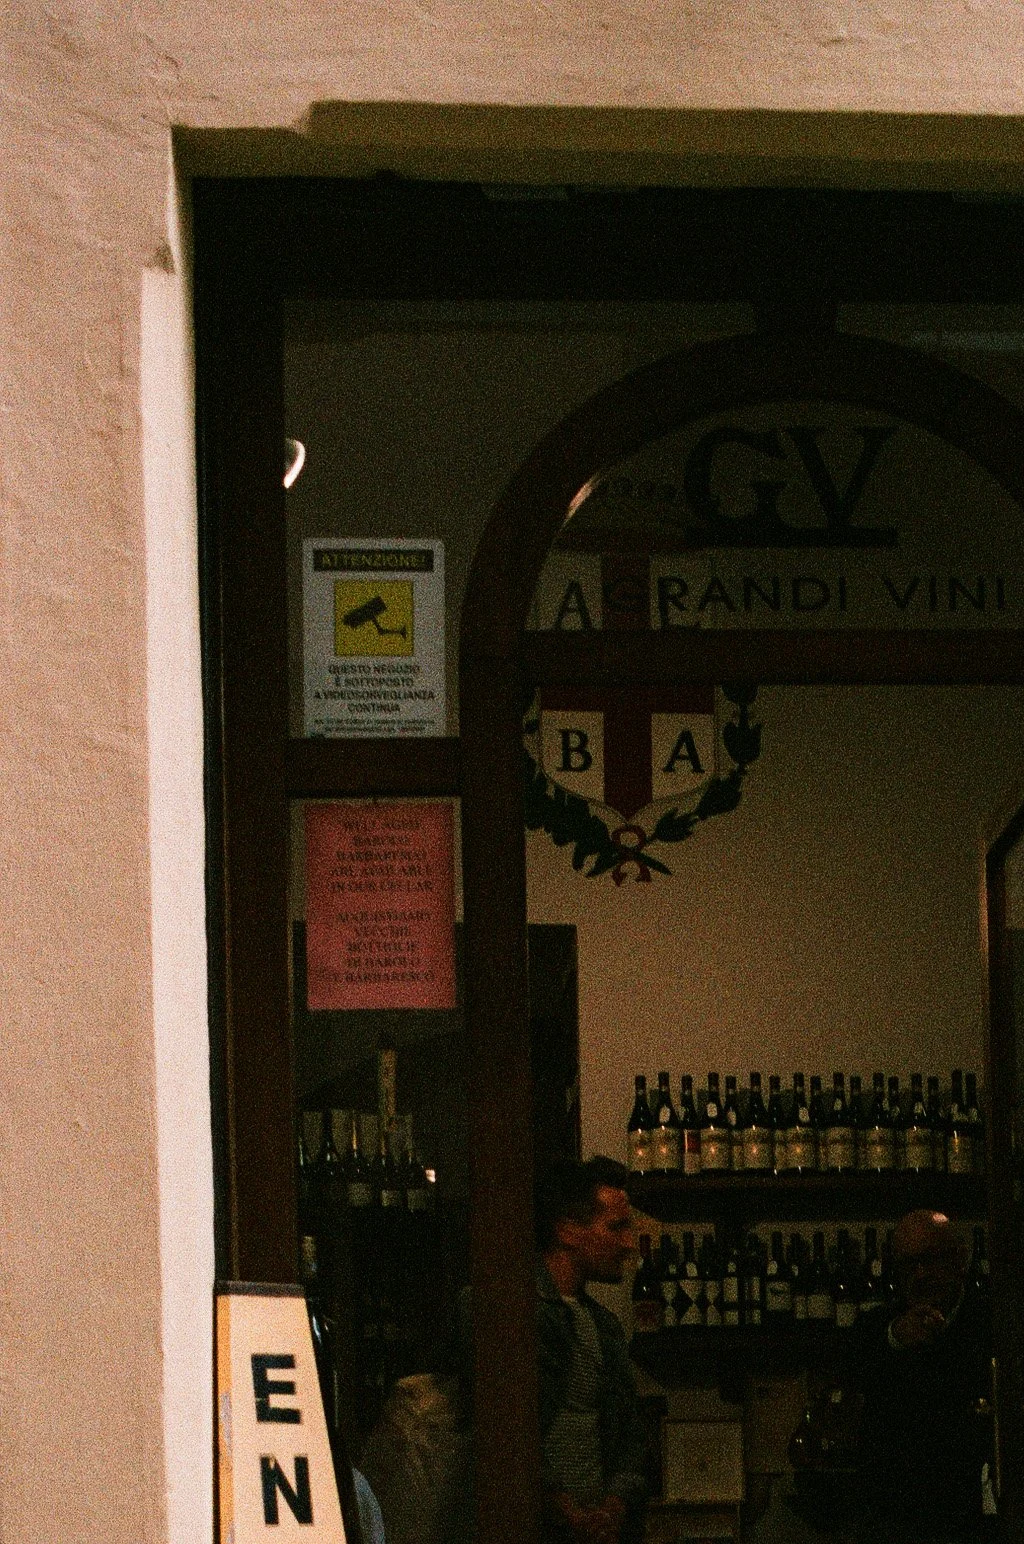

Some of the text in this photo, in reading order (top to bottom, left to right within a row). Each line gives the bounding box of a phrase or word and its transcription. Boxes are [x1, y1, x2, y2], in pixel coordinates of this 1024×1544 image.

[683, 426, 897, 534] GV
[881, 576, 1004, 612] VINI
[556, 728, 704, 773] B A
